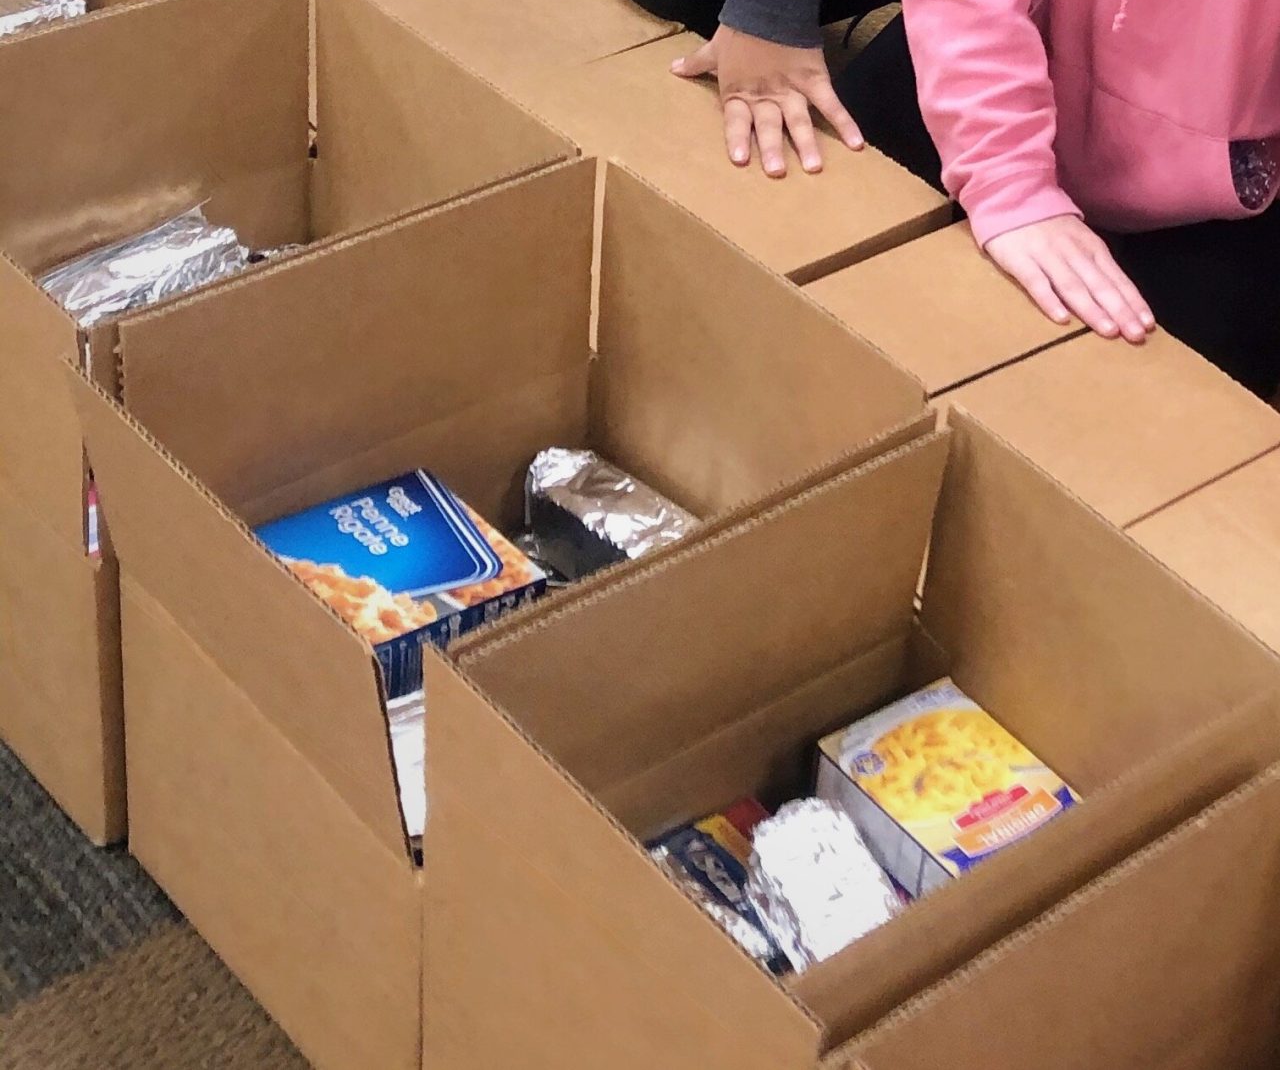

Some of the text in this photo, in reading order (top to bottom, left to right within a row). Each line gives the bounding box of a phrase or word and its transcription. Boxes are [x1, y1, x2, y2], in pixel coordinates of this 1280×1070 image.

[329, 504, 388, 555] Rigate
[351, 496, 408, 547] Penne
[979, 803, 1046, 846] ORIGINAL
